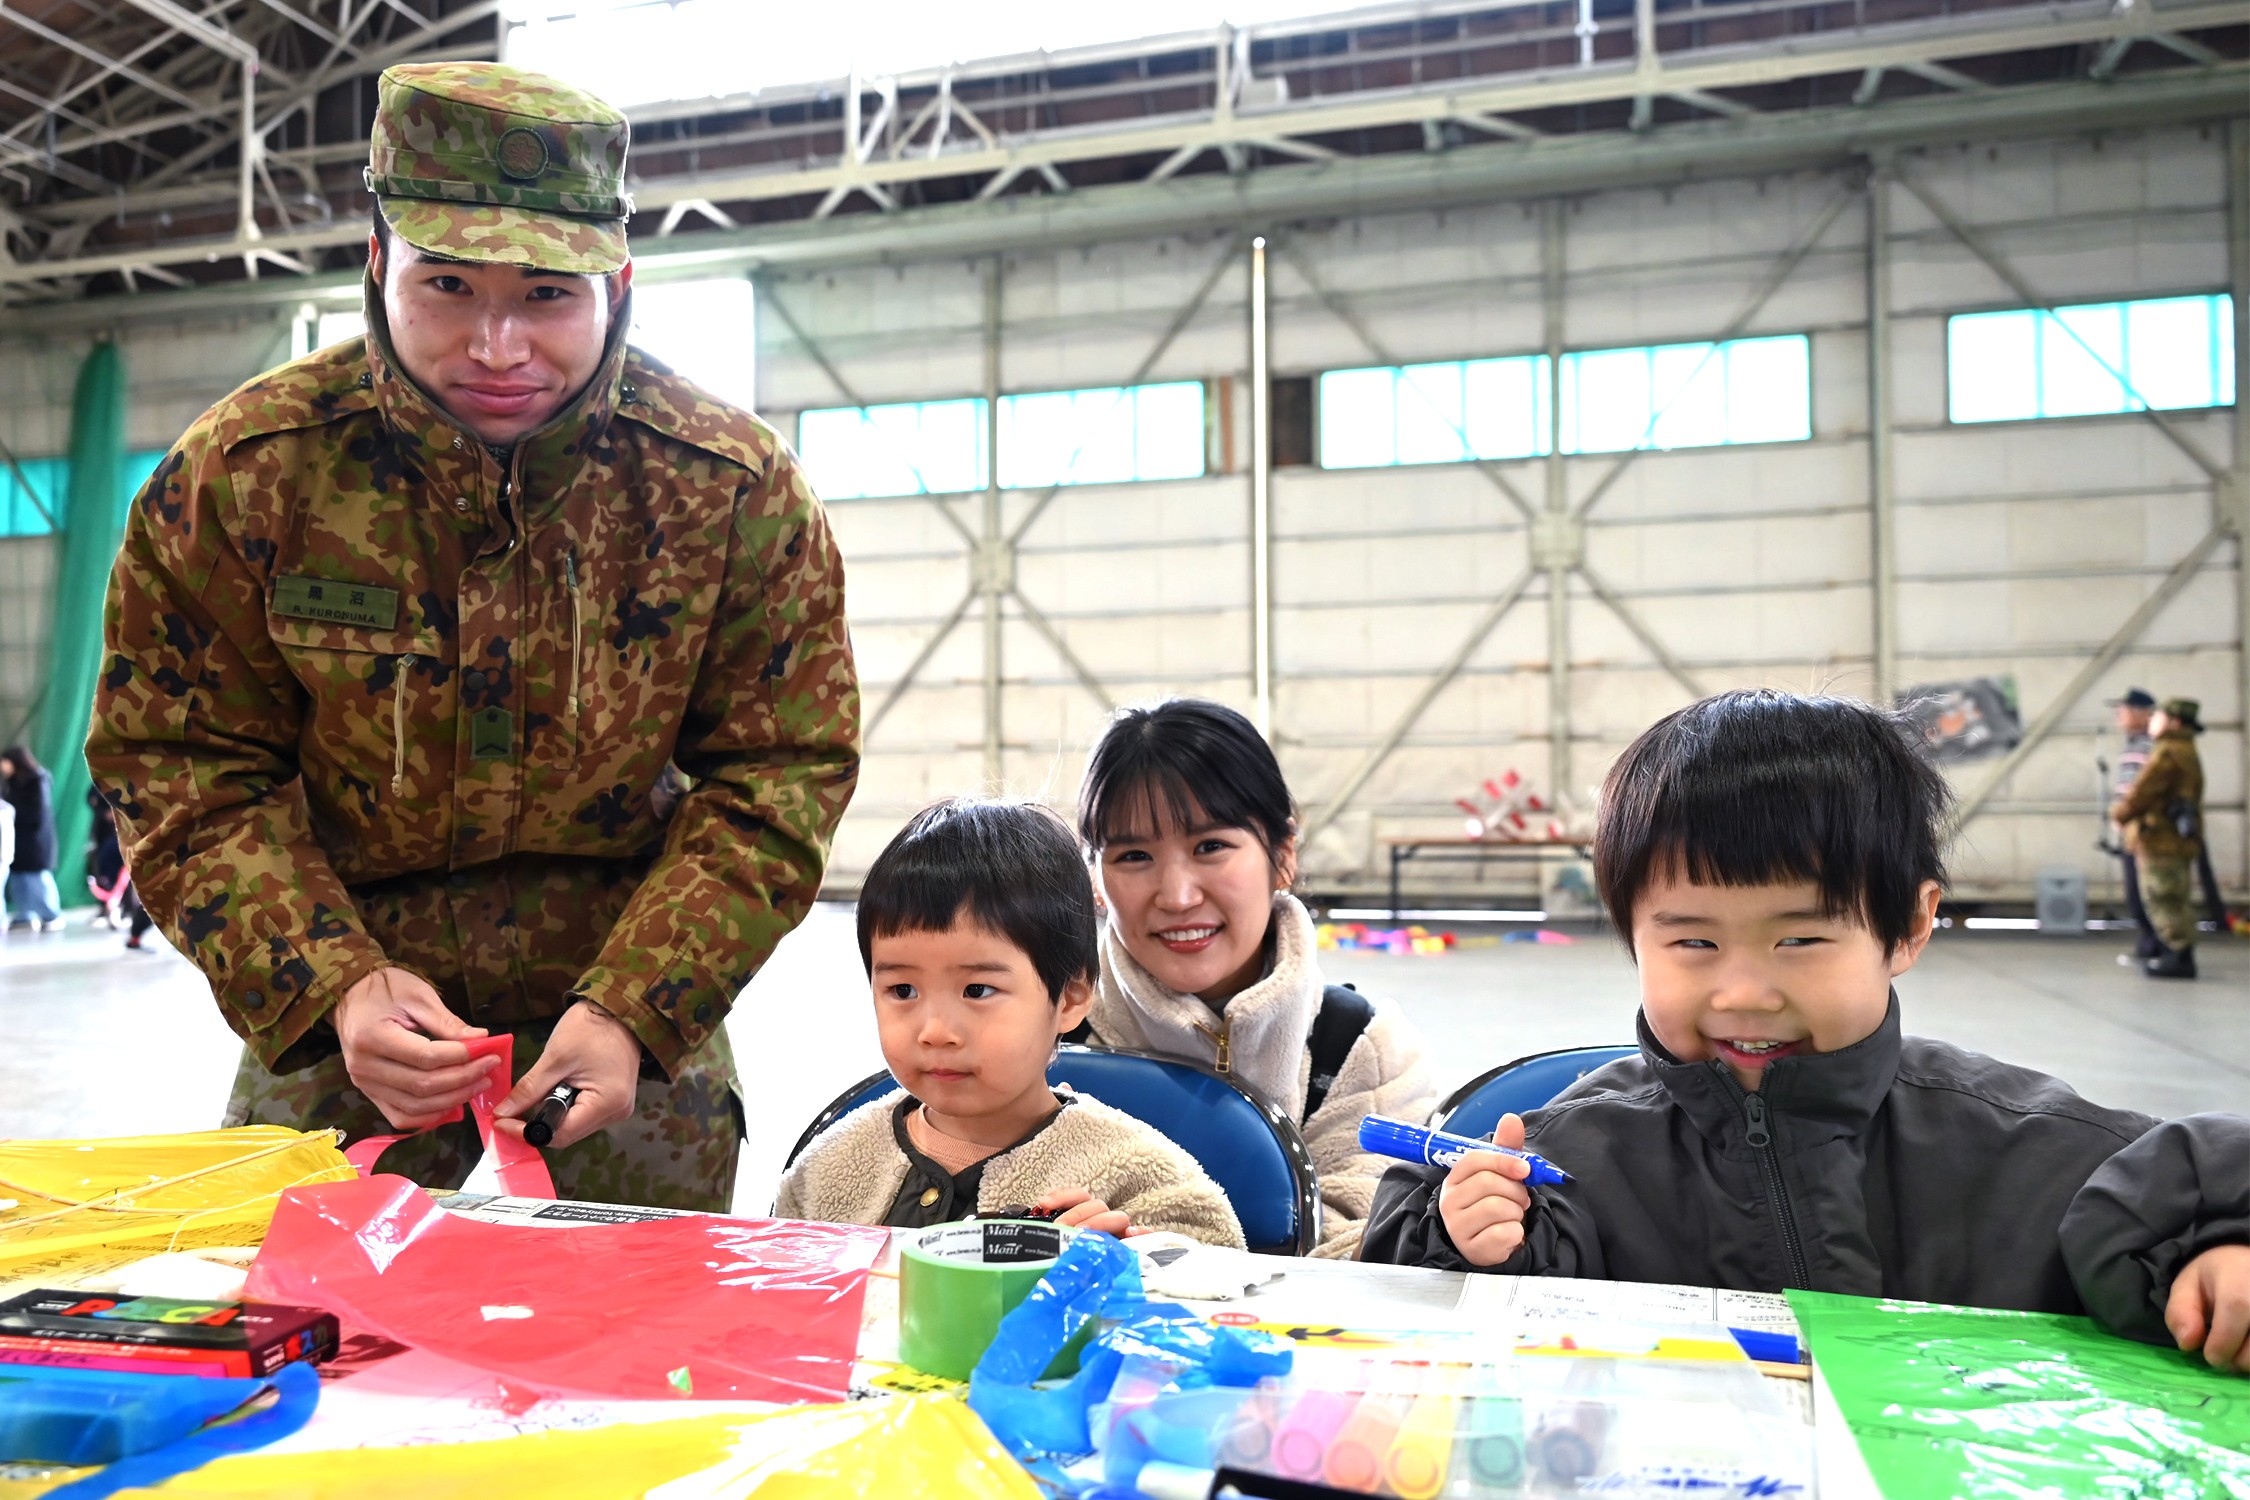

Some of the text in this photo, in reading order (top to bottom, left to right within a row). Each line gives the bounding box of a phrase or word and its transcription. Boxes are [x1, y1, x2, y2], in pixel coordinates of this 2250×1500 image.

[293, 606, 376, 622] R. KURONUMA
[985, 1224, 1022, 1236] Monf
[985, 1243, 1022, 1255] Monf
